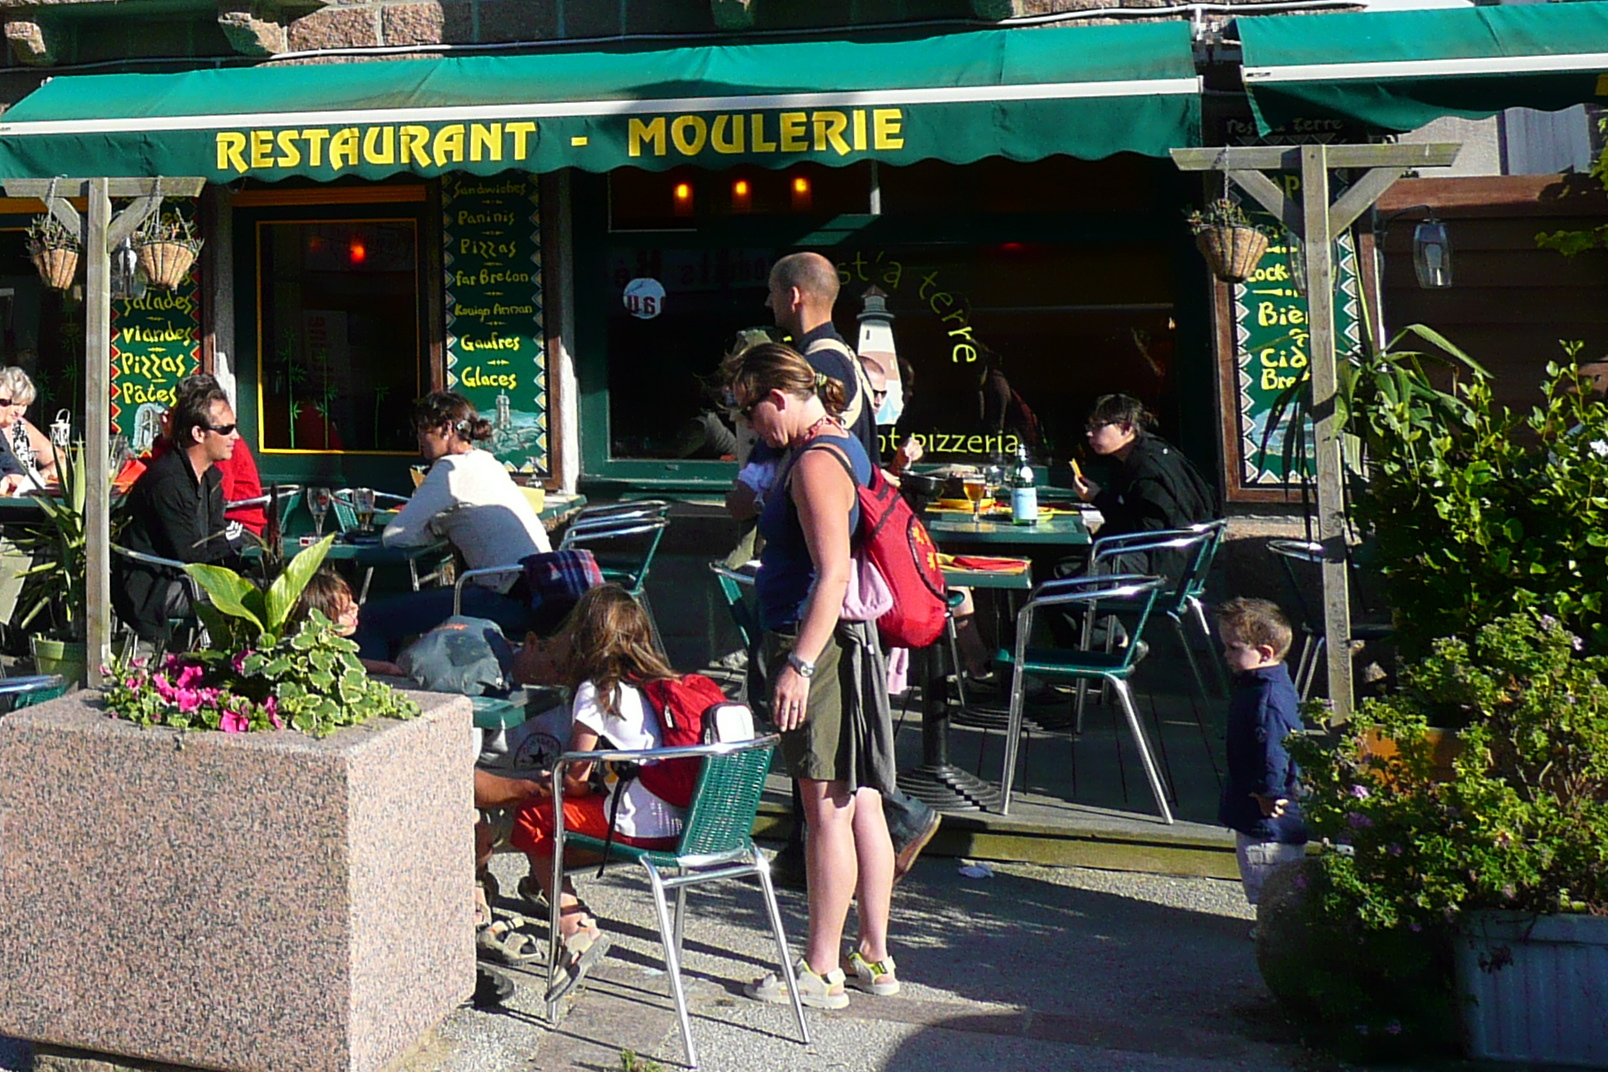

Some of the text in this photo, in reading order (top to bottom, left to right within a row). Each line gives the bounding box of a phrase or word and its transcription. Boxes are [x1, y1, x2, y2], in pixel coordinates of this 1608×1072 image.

[215, 121, 536, 172] RESTAURANT
[628, 108, 905, 157] MOULERIE
[458, 210, 515, 226] Paninis
[460, 238, 517, 259] Pizzas
[918, 270, 978, 364] terre
[460, 331, 521, 352] Gaufres
[121, 352, 187, 379] Pizzas
[461, 365, 518, 391] Glaces
[122, 382, 178, 407] Pâtes
[912, 429, 1020, 454] pizzeria
